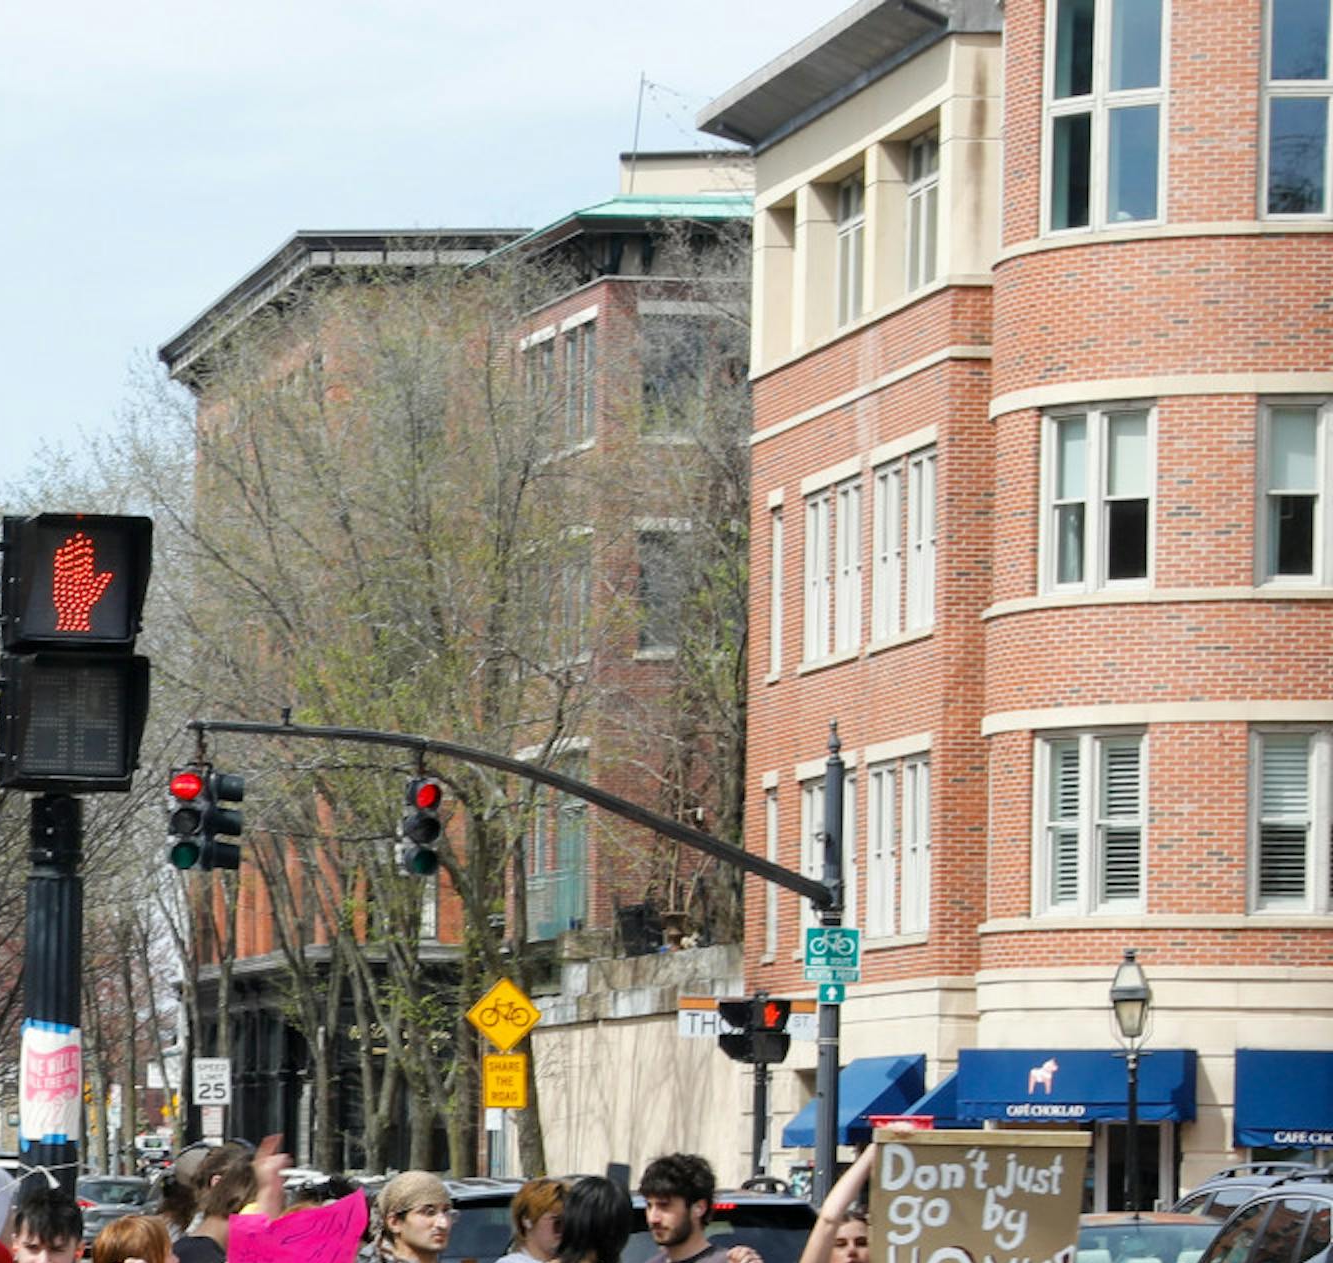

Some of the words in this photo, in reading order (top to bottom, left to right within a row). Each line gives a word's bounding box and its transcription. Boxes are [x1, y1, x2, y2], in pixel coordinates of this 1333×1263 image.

[197, 1063, 228, 1072] SPEED
[489, 1061, 520, 1073] SHARE
[495, 1075, 514, 1087] THE
[198, 1083, 227, 1100] 25
[880, 1143, 990, 1192] Don't
[994, 1153, 1065, 1198] just
[886, 1195, 952, 1245] go
[981, 1187, 1027, 1250] by
